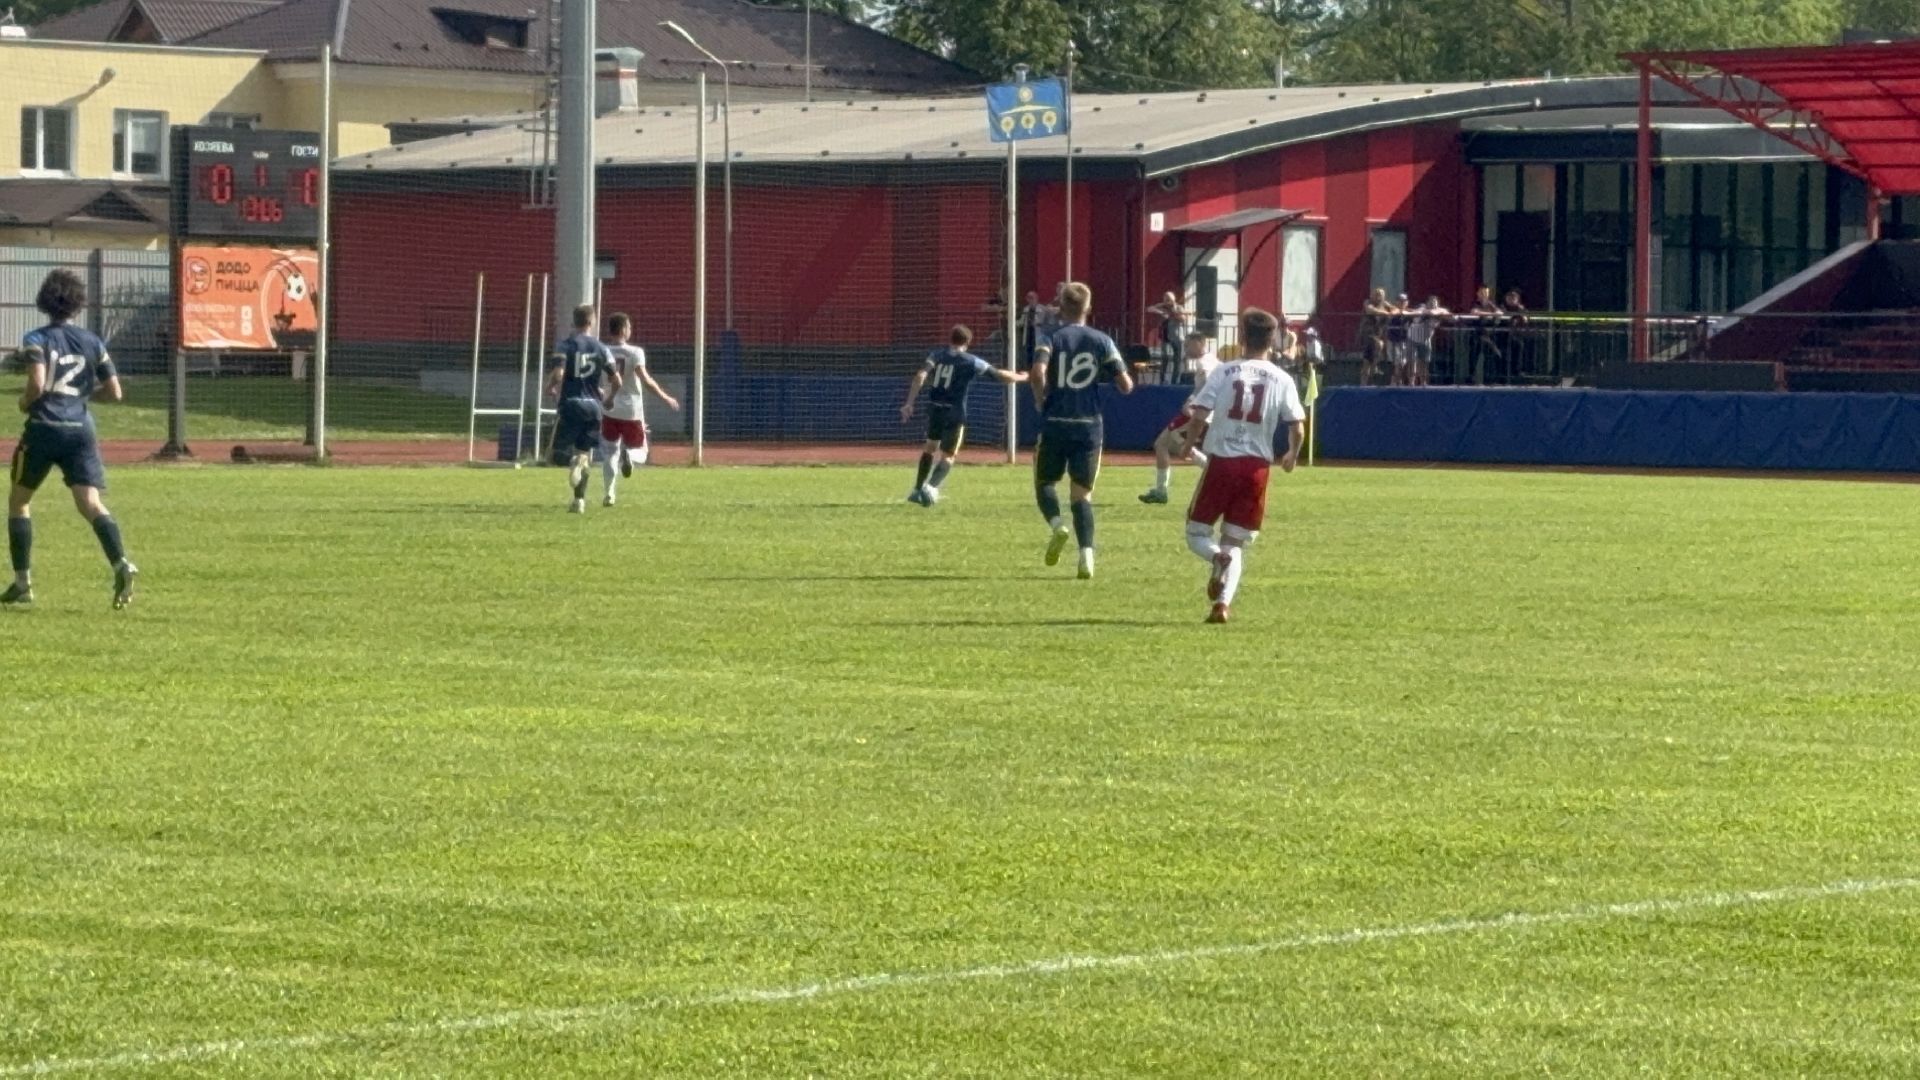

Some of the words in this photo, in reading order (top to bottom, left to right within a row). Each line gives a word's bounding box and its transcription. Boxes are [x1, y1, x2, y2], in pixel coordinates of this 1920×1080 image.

[215, 261, 252, 275] ДОДО
[215, 279, 260, 292] ПИЦЦА
[45, 350, 86, 396] 12
[575, 351, 598, 378] 15
[933, 363, 955, 389] 14
[1058, 351, 1097, 389] 18
[1227, 379, 1265, 425] 11
